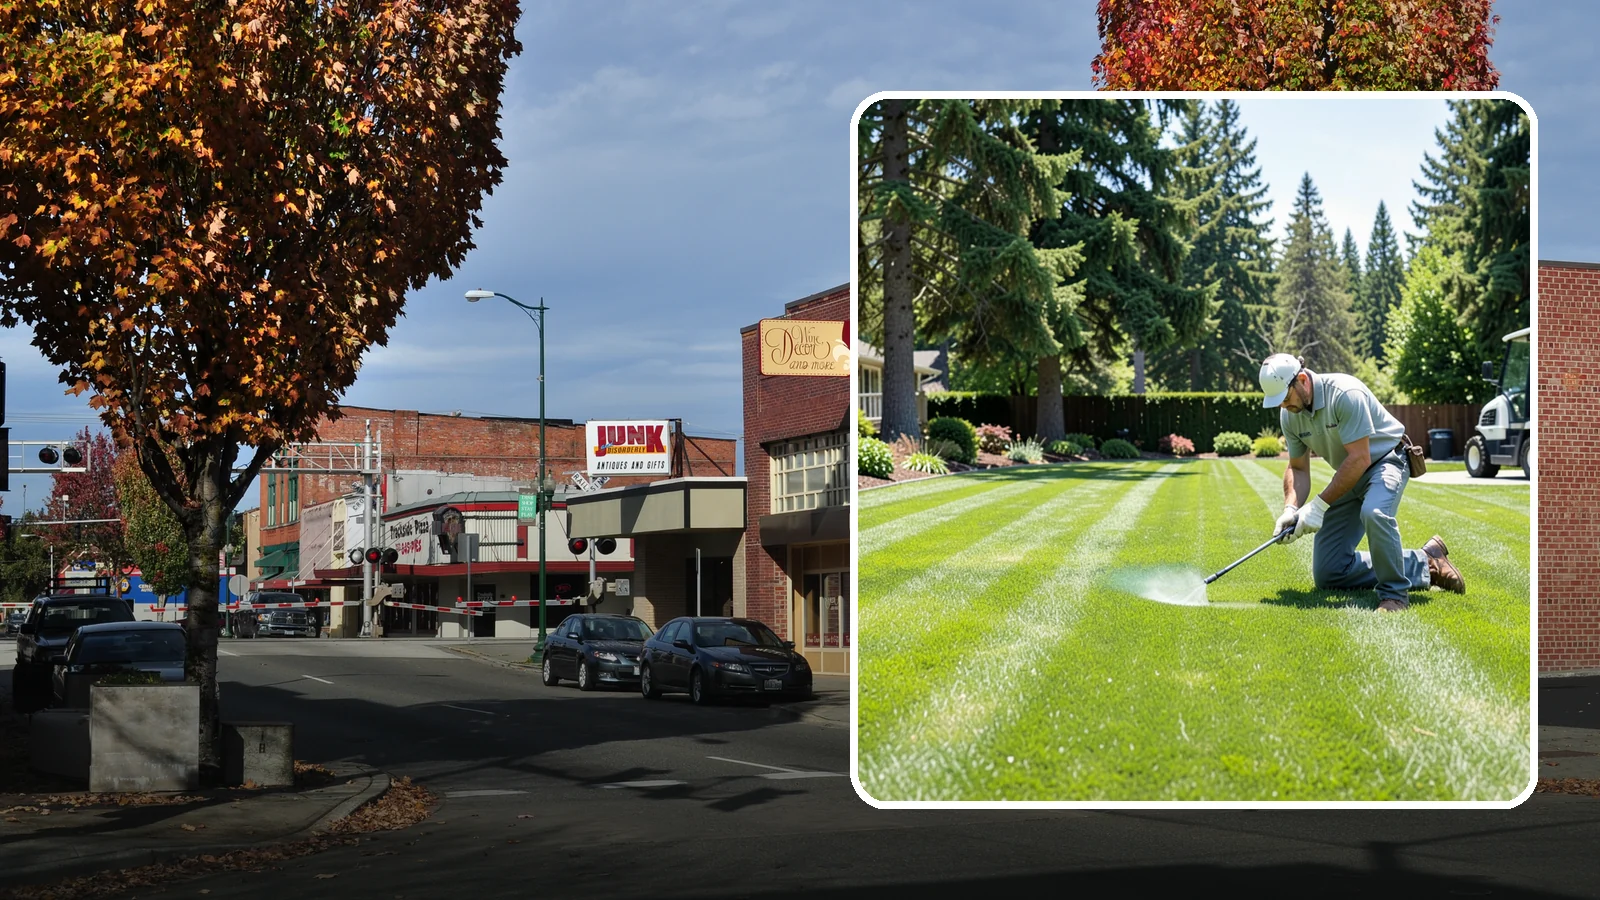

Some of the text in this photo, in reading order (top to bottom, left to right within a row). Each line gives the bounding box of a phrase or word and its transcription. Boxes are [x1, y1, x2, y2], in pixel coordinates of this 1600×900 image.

[595, 425, 664, 457] JUNK
[607, 446, 646, 454] DISORDERLY
[597, 460, 665, 470] ANTIQUES AND GIFTS
[414, 519, 429, 534] Pizza
